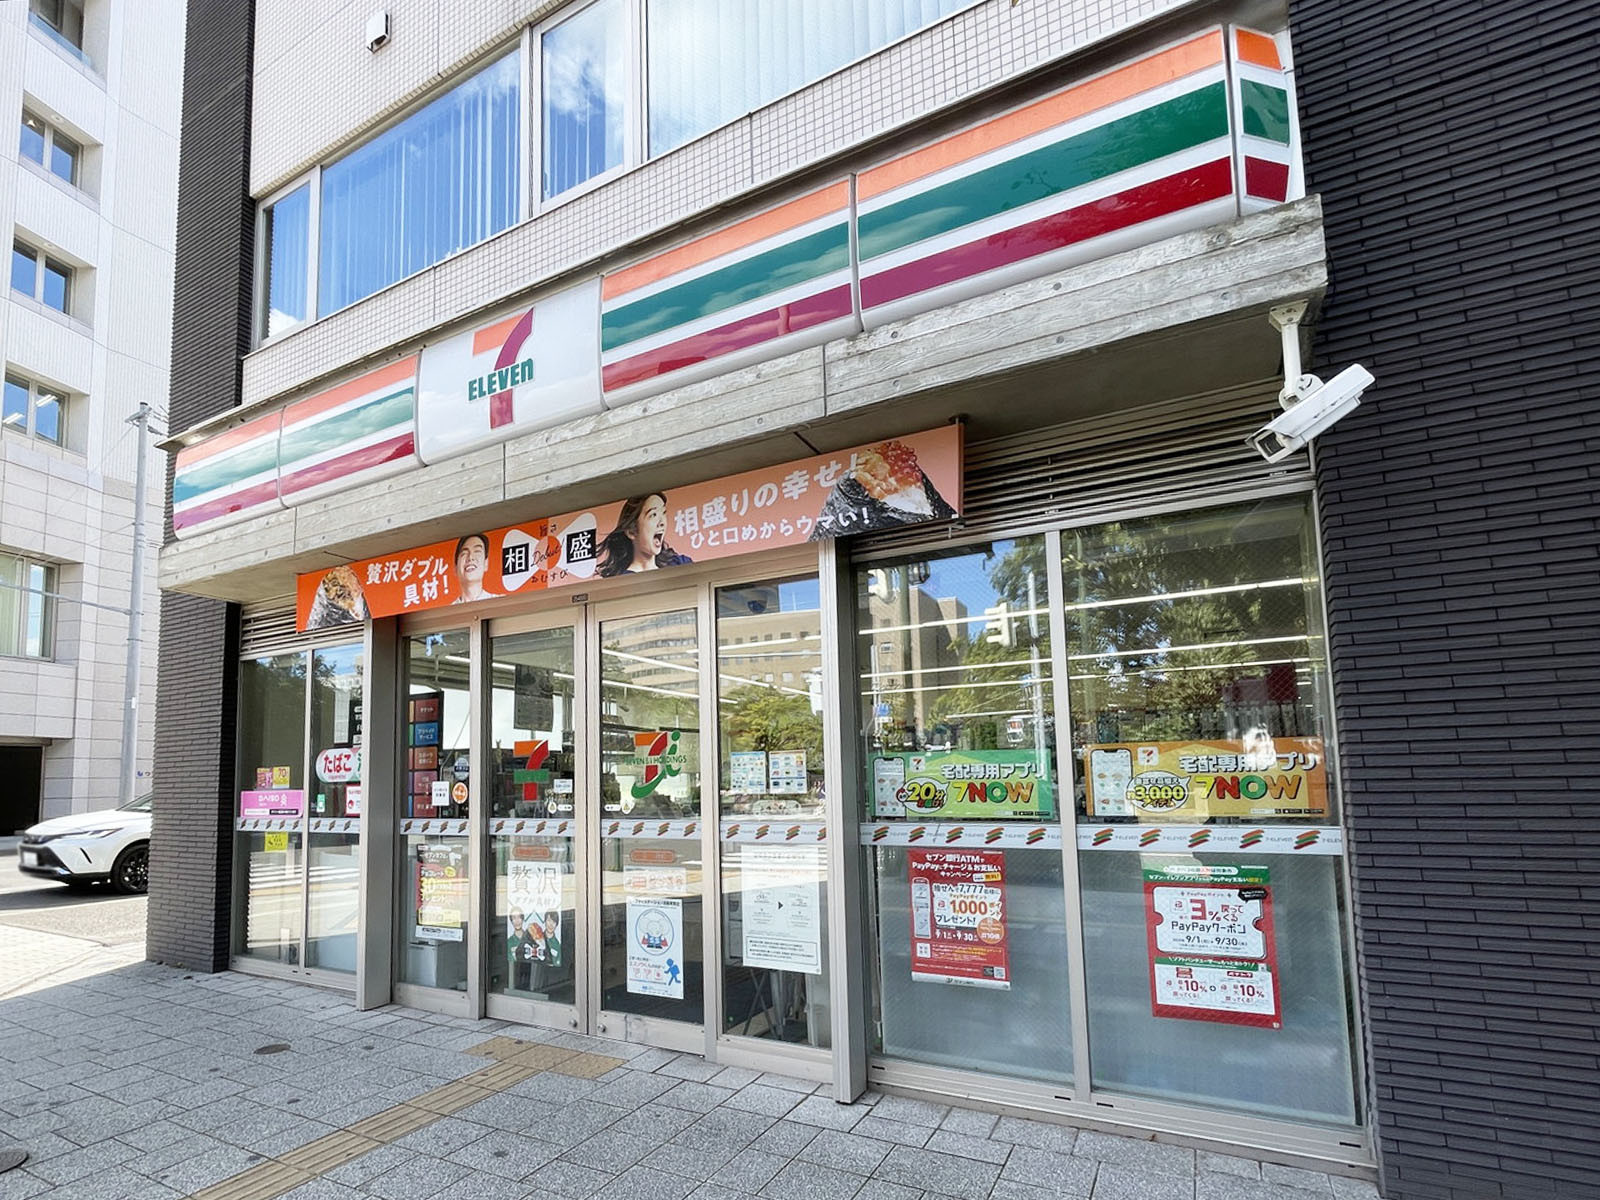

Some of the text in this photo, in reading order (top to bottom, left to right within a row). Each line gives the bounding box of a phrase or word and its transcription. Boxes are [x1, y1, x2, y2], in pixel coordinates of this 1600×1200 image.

[473, 307, 534, 429] 7
[674, 453, 859, 536] 相盛りの幸せ!
[690, 507, 870, 549] ひと口めからウマい!
[569, 532, 592, 561] 盛
[366, 555, 449, 585] 贅沢ダブル
[505, 547, 526, 573] 相
[403, 575, 449, 608] 具材!
[323, 753, 352, 774] たばこ
[942, 761, 1046, 780] 宅配専用アプリ
[952, 781, 1034, 804] 7NOW
[1195, 774, 1302, 800] 7NOW
[935, 914, 976, 926] プレゼント!
[1171, 921, 1247, 935] PayPayクーポン
